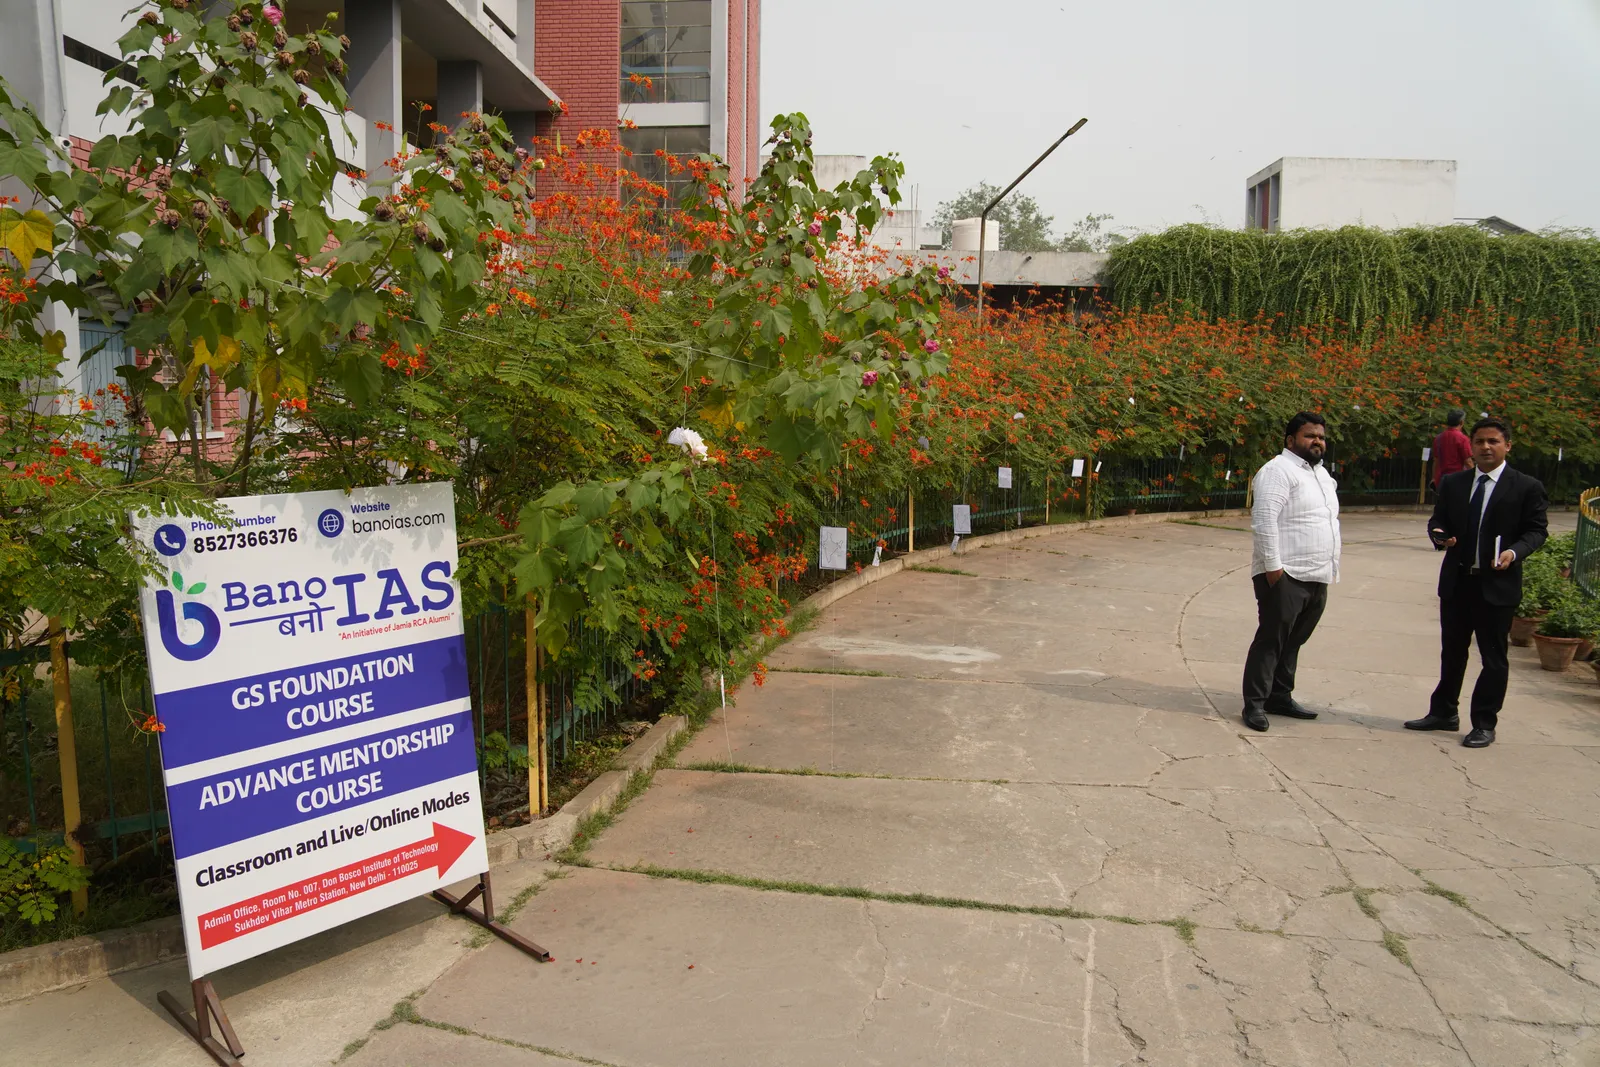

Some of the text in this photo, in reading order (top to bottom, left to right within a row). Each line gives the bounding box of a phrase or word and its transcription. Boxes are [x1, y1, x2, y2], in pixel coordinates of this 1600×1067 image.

[350, 501, 391, 514] Website
[352, 512, 446, 534] banoias.com
[194, 527, 298, 554] 8527366376
[221, 560, 454, 626] Bano IAS
[352, 627, 383, 638] Initiative
[384, 624, 392, 632] of
[392, 620, 412, 632] Jamia
[413, 618, 428, 627] RCA
[231, 653, 414, 710] GS FOUNDATION
[286, 692, 374, 730] COURSE
[199, 723, 454, 810] ADVANCE MENTORSHIP
[296, 771, 383, 813] COURSE
[196, 791, 470, 887] Classroom and Live/Online Modes
[204, 842, 438, 930] Admin Office, Room No. 007, Don Bosco Institute of Technology
[234, 914, 270, 933] Sukhdev
[272, 904, 293, 919] Vihar
[295, 897, 318, 911] Metro
[320, 887, 348, 902] Station,
[350, 880, 366, 892] New
[368, 872, 386, 886] Delhi
[392, 860, 418, 876] 110025
